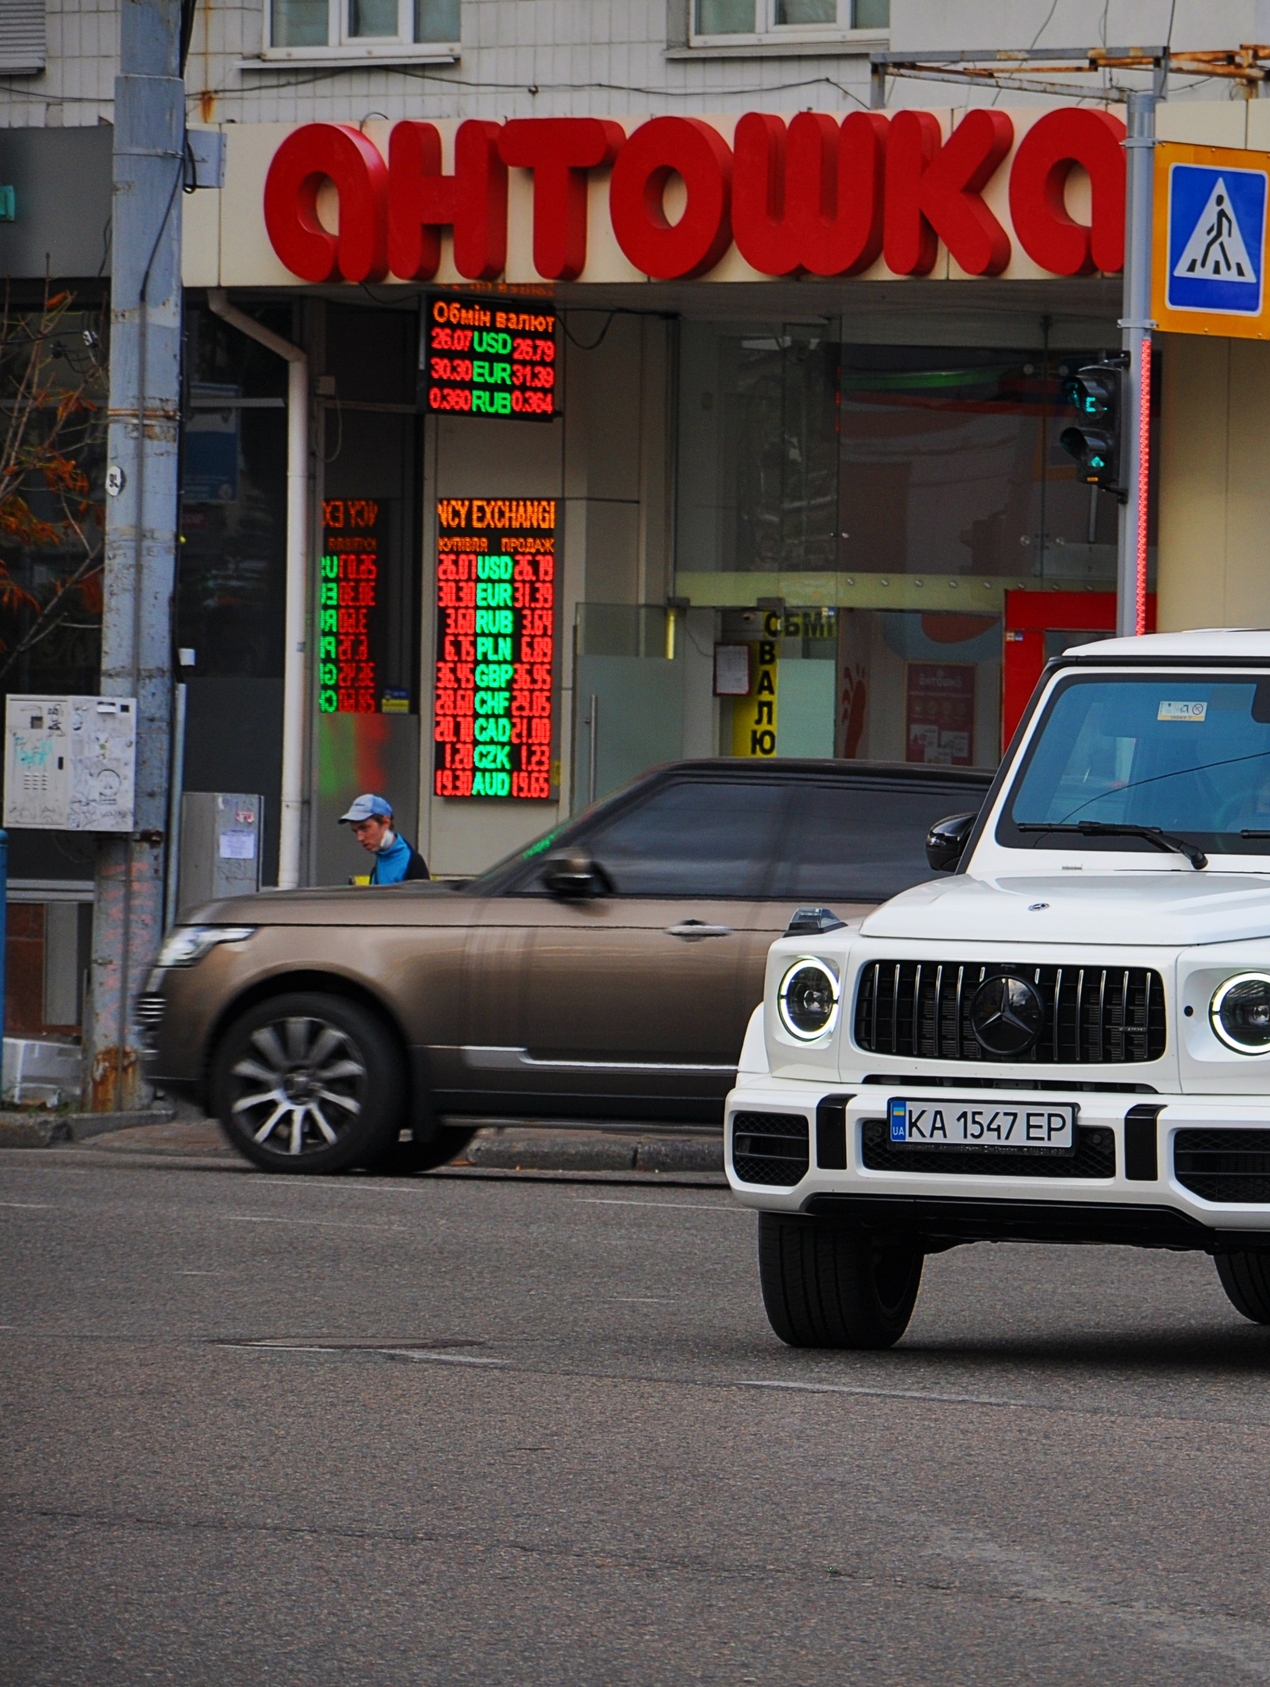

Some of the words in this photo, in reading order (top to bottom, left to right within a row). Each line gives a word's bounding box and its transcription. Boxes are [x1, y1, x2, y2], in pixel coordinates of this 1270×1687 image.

[433, 301, 491, 327] Обмін
[495, 312, 555, 332] валют
[473, 330, 512, 354] USD
[472, 361, 512, 385] EUR
[472, 390, 511, 414] RUB
[501, 537, 555, 553] ПРОДАЖ
[477, 555, 513, 580] USD
[476, 582, 513, 607] EUR
[476, 609, 513, 634] RUB
[476, 637, 512, 661] PLN
[475, 663, 514, 688] GBP
[474, 690, 511, 715] CHF
[474, 717, 512, 742] CAD
[473, 744, 511, 769] CZK
[472, 771, 511, 796] AUD
[892, 1126, 905, 1136] UA
[908, 1109, 947, 1139] KA
[956, 1111, 1018, 1141] 1547
[1026, 1112, 1067, 1142] EP
